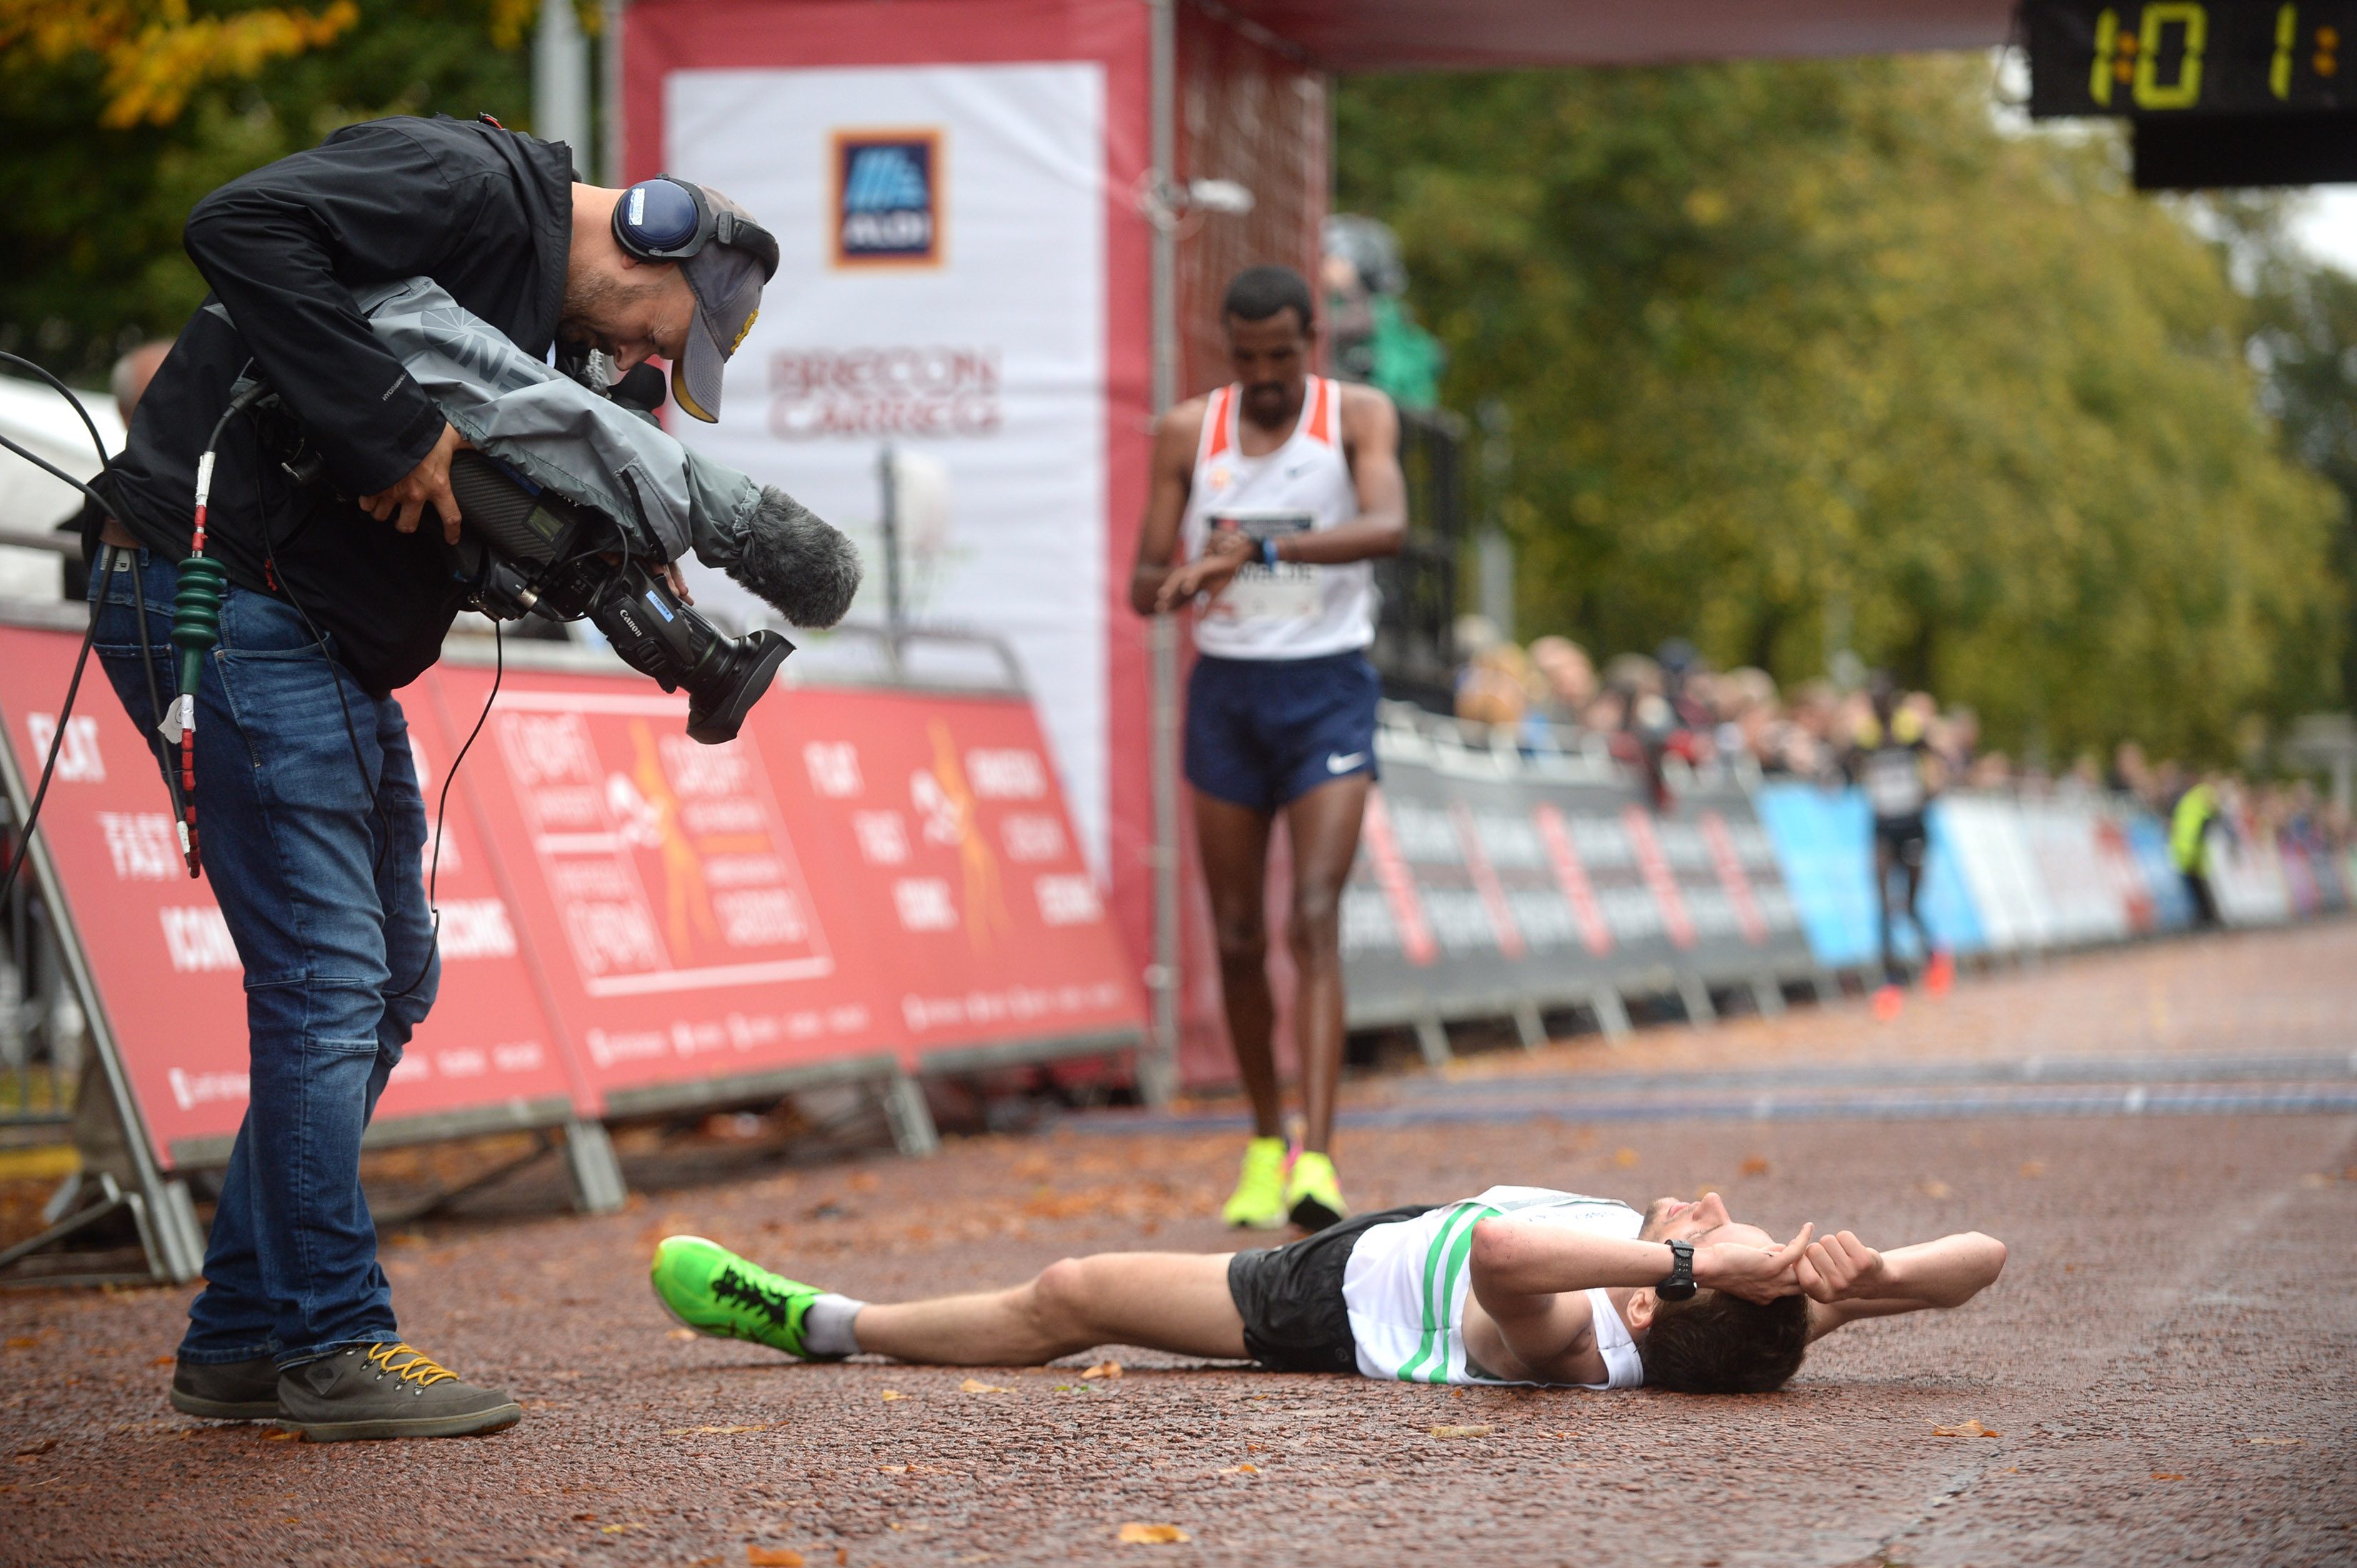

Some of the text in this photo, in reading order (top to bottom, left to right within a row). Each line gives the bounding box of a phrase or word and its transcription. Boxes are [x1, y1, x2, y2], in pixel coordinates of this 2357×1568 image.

[769, 347, 1000, 397] BRECON
[769, 394, 1001, 441] CARREG
[619, 609, 642, 637] Canon
[26, 711, 106, 783] FLAT
[99, 810, 180, 881] FAST
[159, 905, 244, 973] ICON
